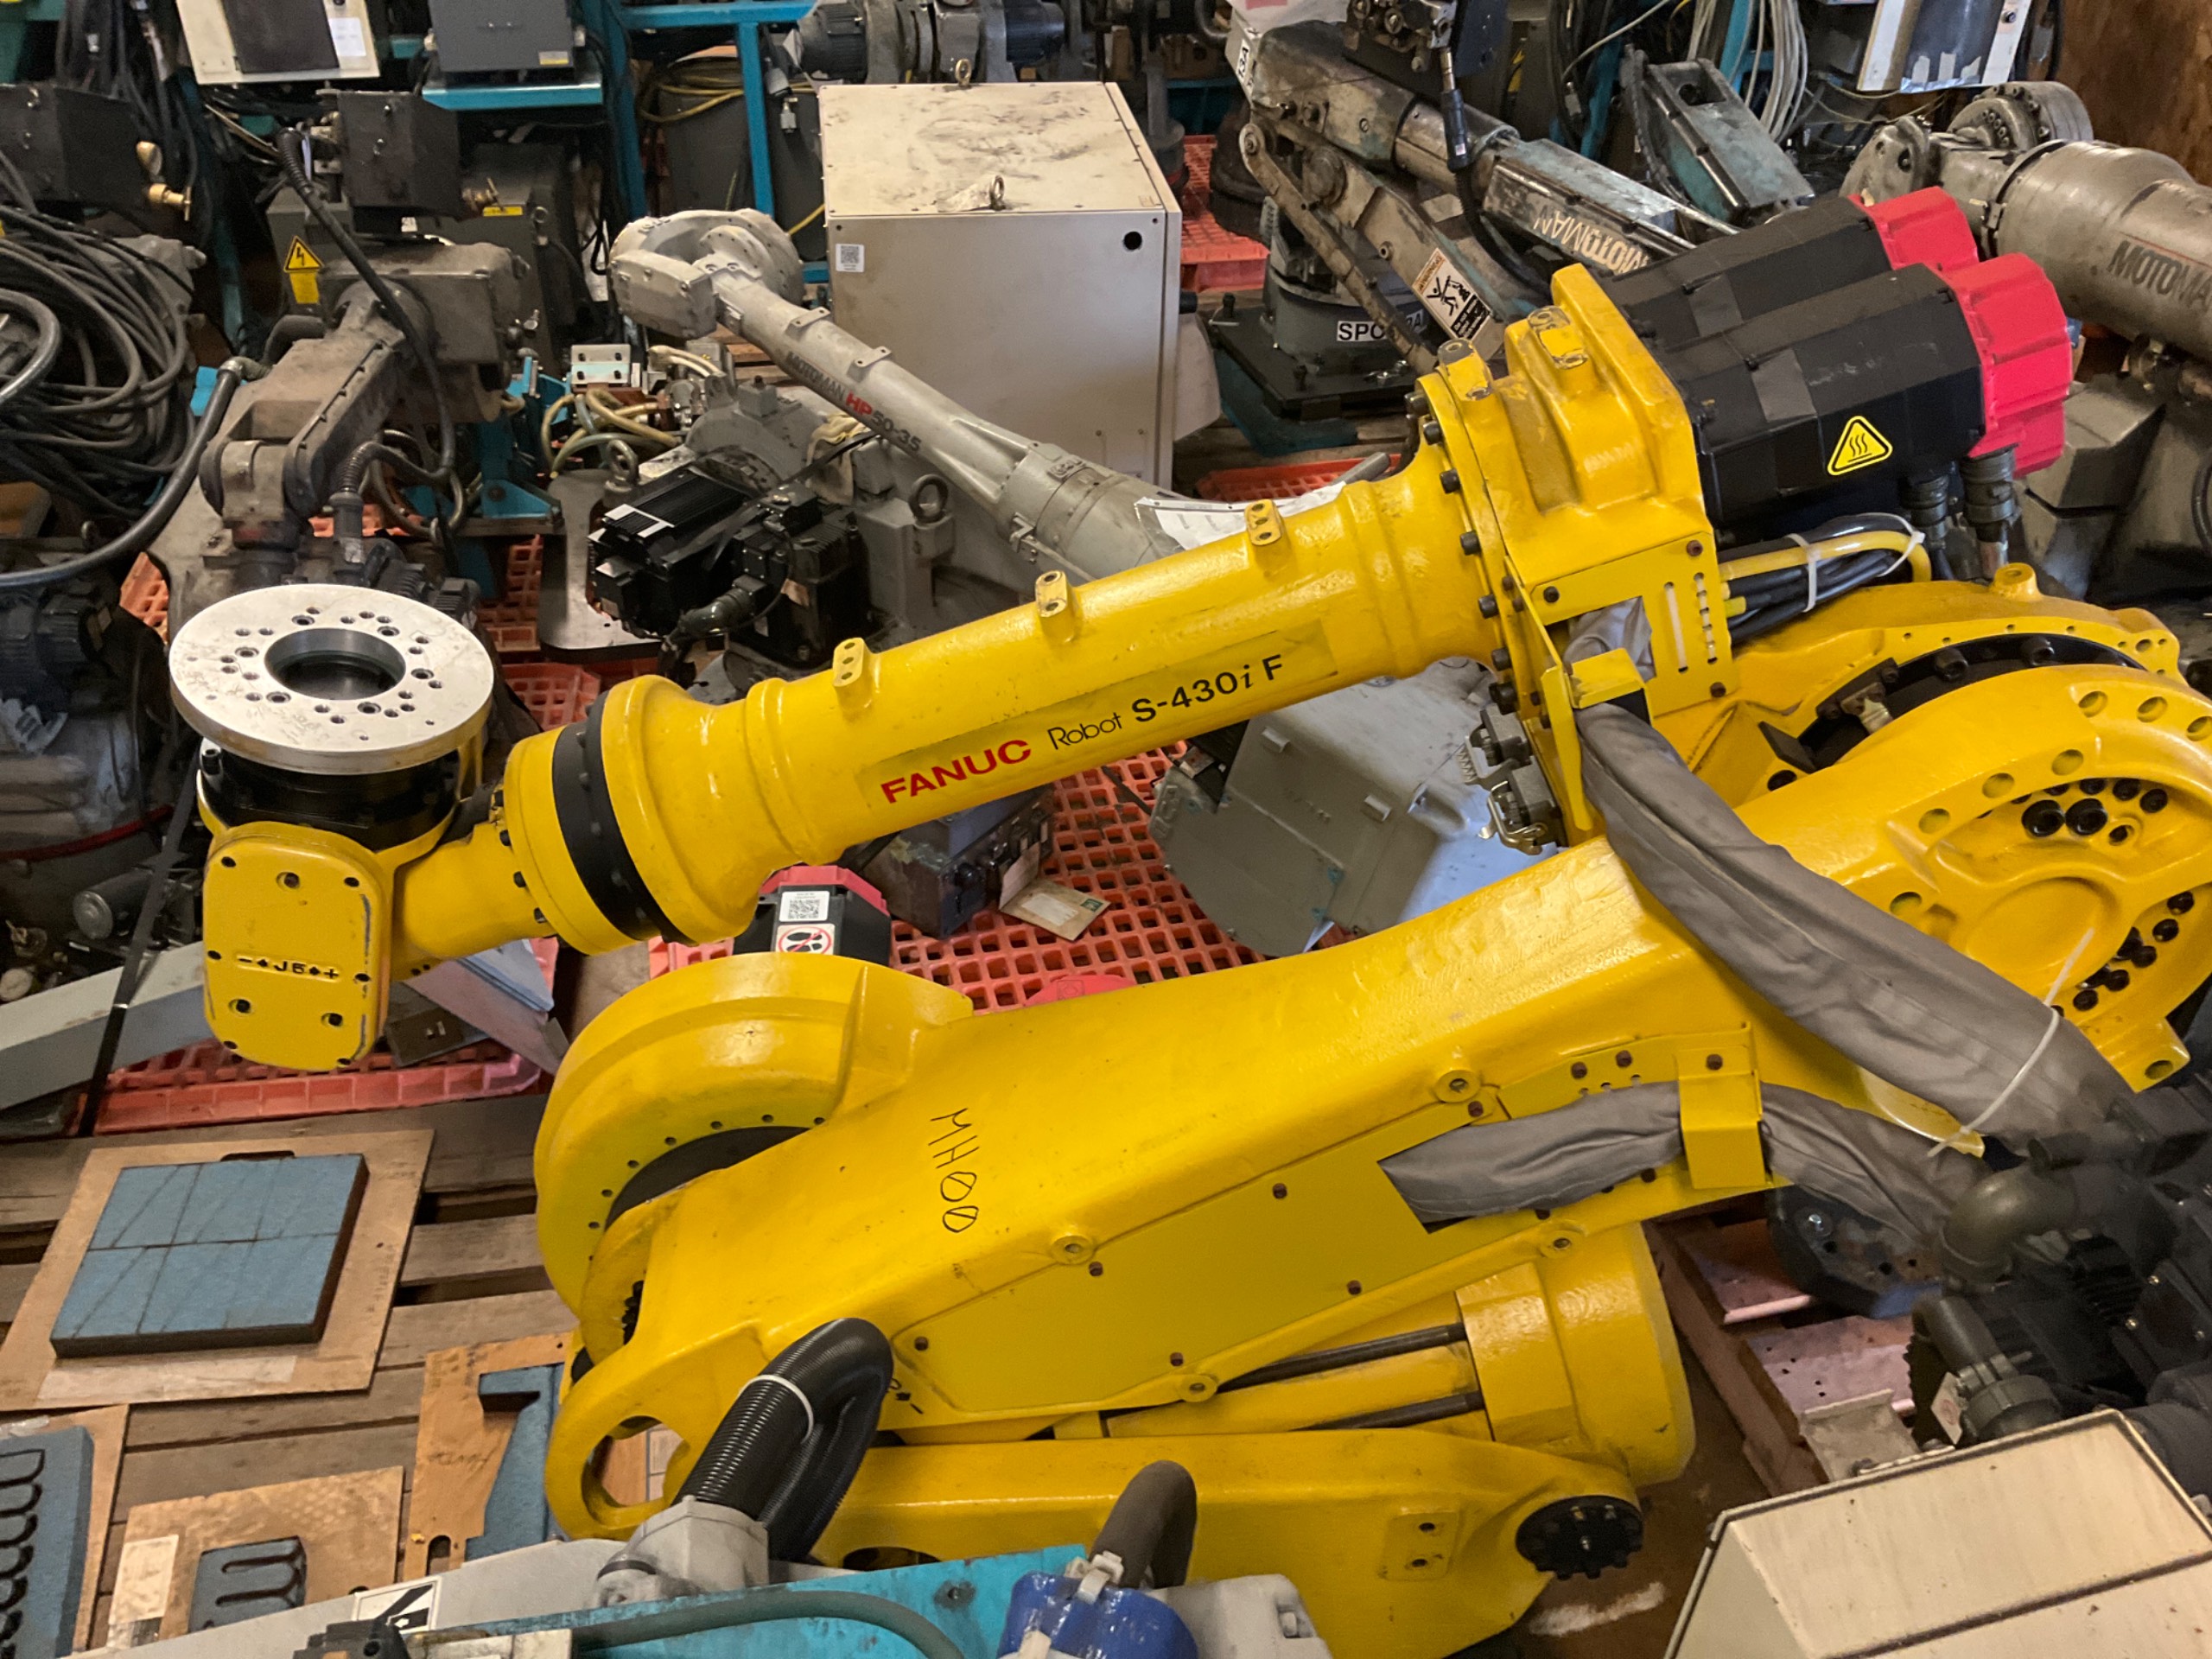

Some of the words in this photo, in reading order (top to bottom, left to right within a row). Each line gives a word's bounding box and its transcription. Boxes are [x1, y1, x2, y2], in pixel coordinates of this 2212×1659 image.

[880, 740, 1032, 804] FANUC
[1047, 712, 1122, 750] Robot
[1131, 664, 1254, 722] S-430i
[1262, 654, 1283, 680] F
